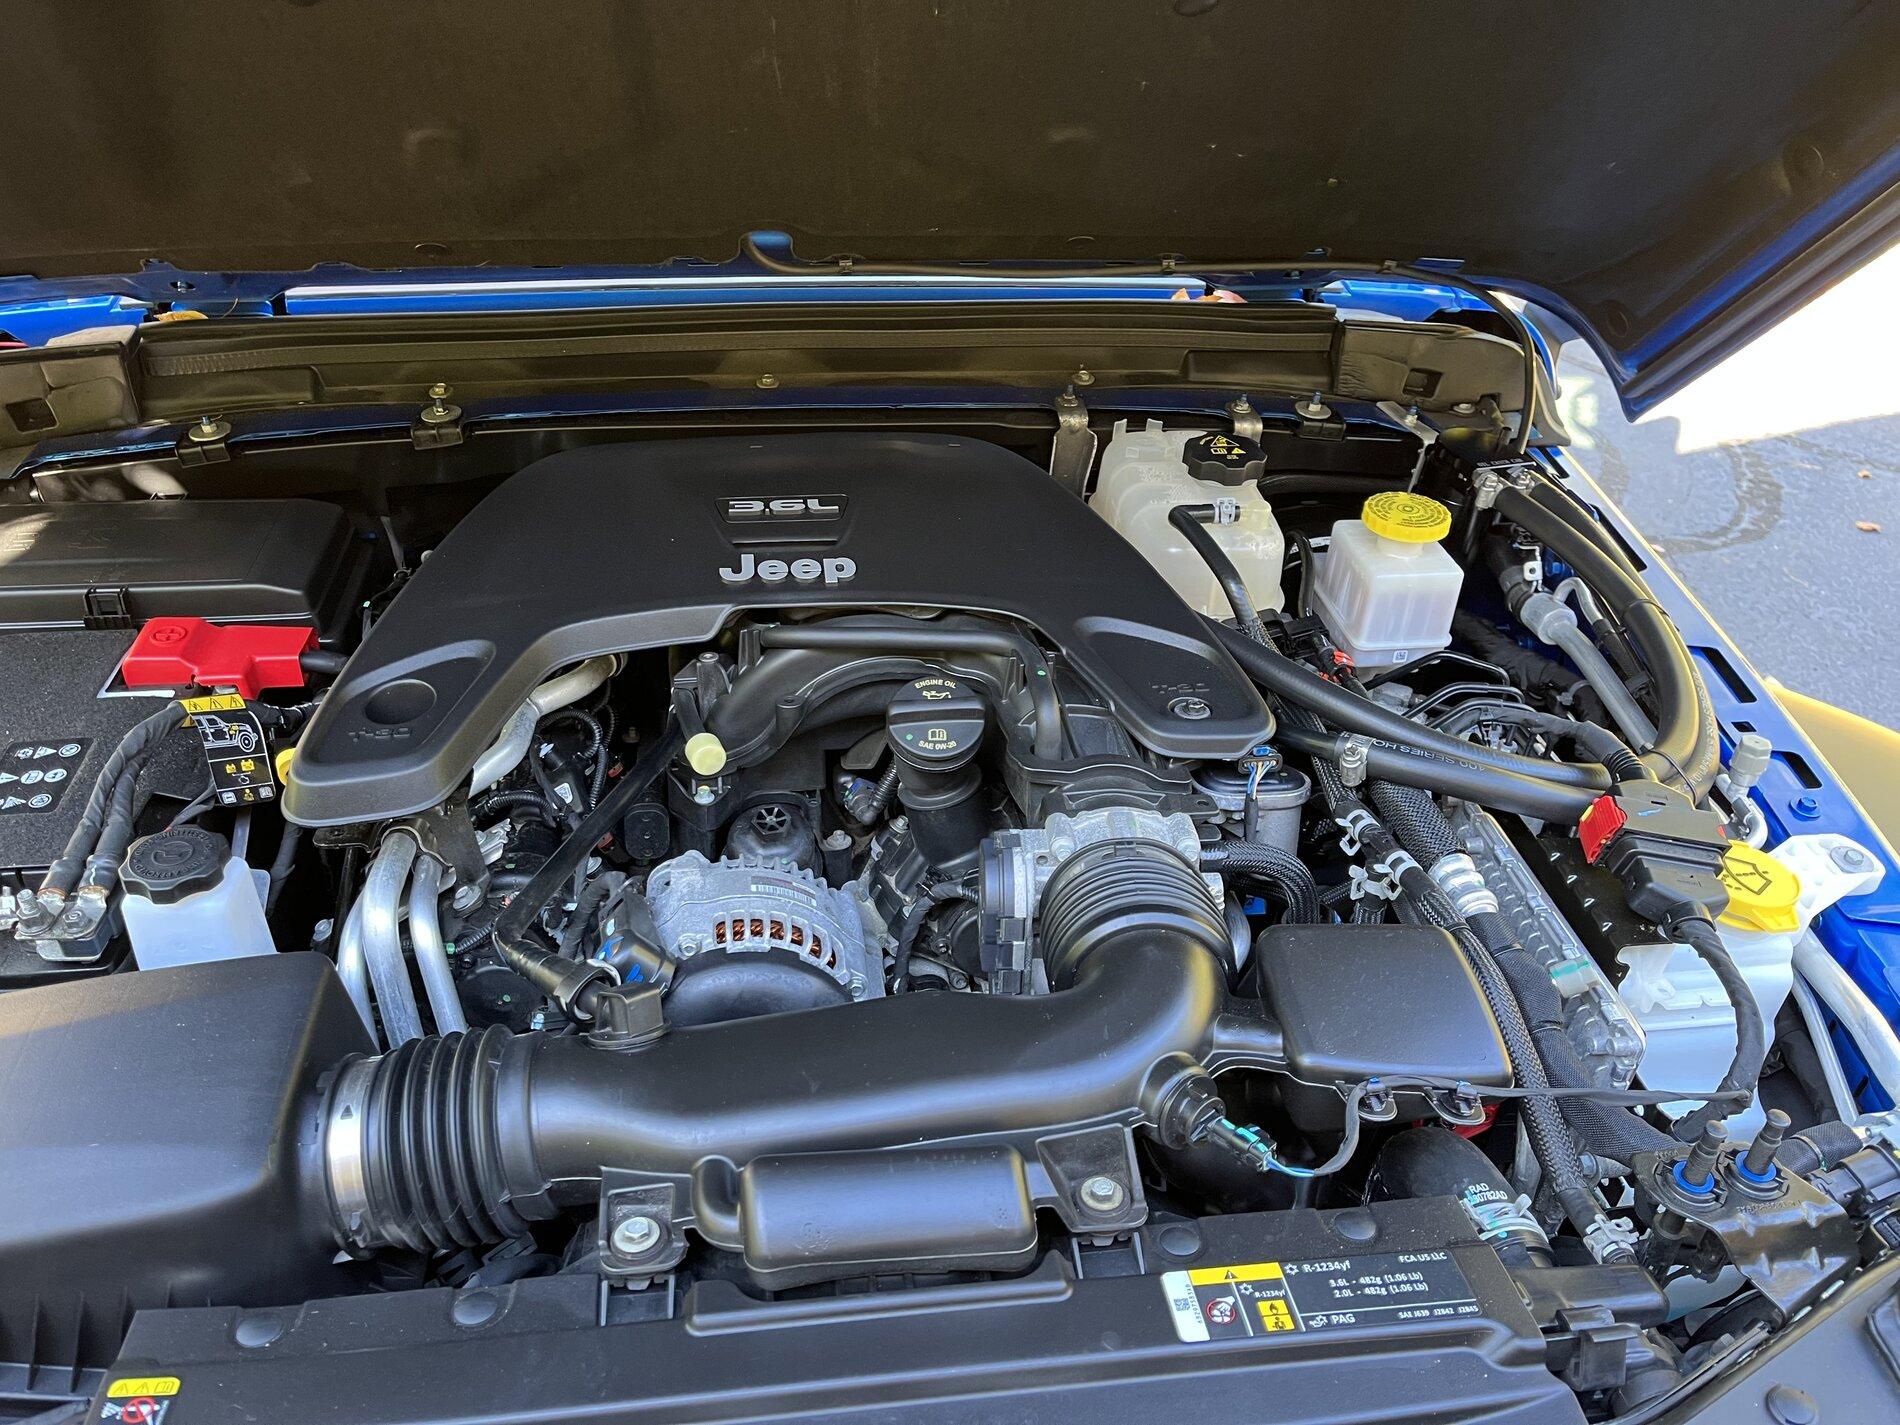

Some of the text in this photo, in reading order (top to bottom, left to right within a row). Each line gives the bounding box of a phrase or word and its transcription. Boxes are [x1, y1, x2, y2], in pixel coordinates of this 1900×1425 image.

[728, 498, 839, 516] 3.6L
[718, 553, 857, 587] Jeep
[914, 679, 957, 690] ENGINE OIL
[918, 740, 957, 750] SAE 0W-20
[1400, 745, 1455, 765] SERIES
[1468, 1182, 1489, 1194] RAD
[1398, 1251, 1447, 1264] FCA US LLC
[1302, 1260, 1351, 1273] R-1234yf
[1329, 1278, 1349, 1288] 3.6L
[1359, 1275, 1383, 1285] 482g
[1384, 1272, 1408, 1283] (1.06
[1408, 1271, 1424, 1281] Lb)
[1254, 1289, 1286, 1299] R-1234yf
[1333, 1288, 1354, 1298] 2.0L
[1364, 1286, 1388, 1296] 482g
[1389, 1283, 1413, 1294] (1.06
[1413, 1281, 1429, 1292] Lb)
[1331, 1313, 1356, 1325] PAG
[1398, 1311, 1413, 1319] SAE
